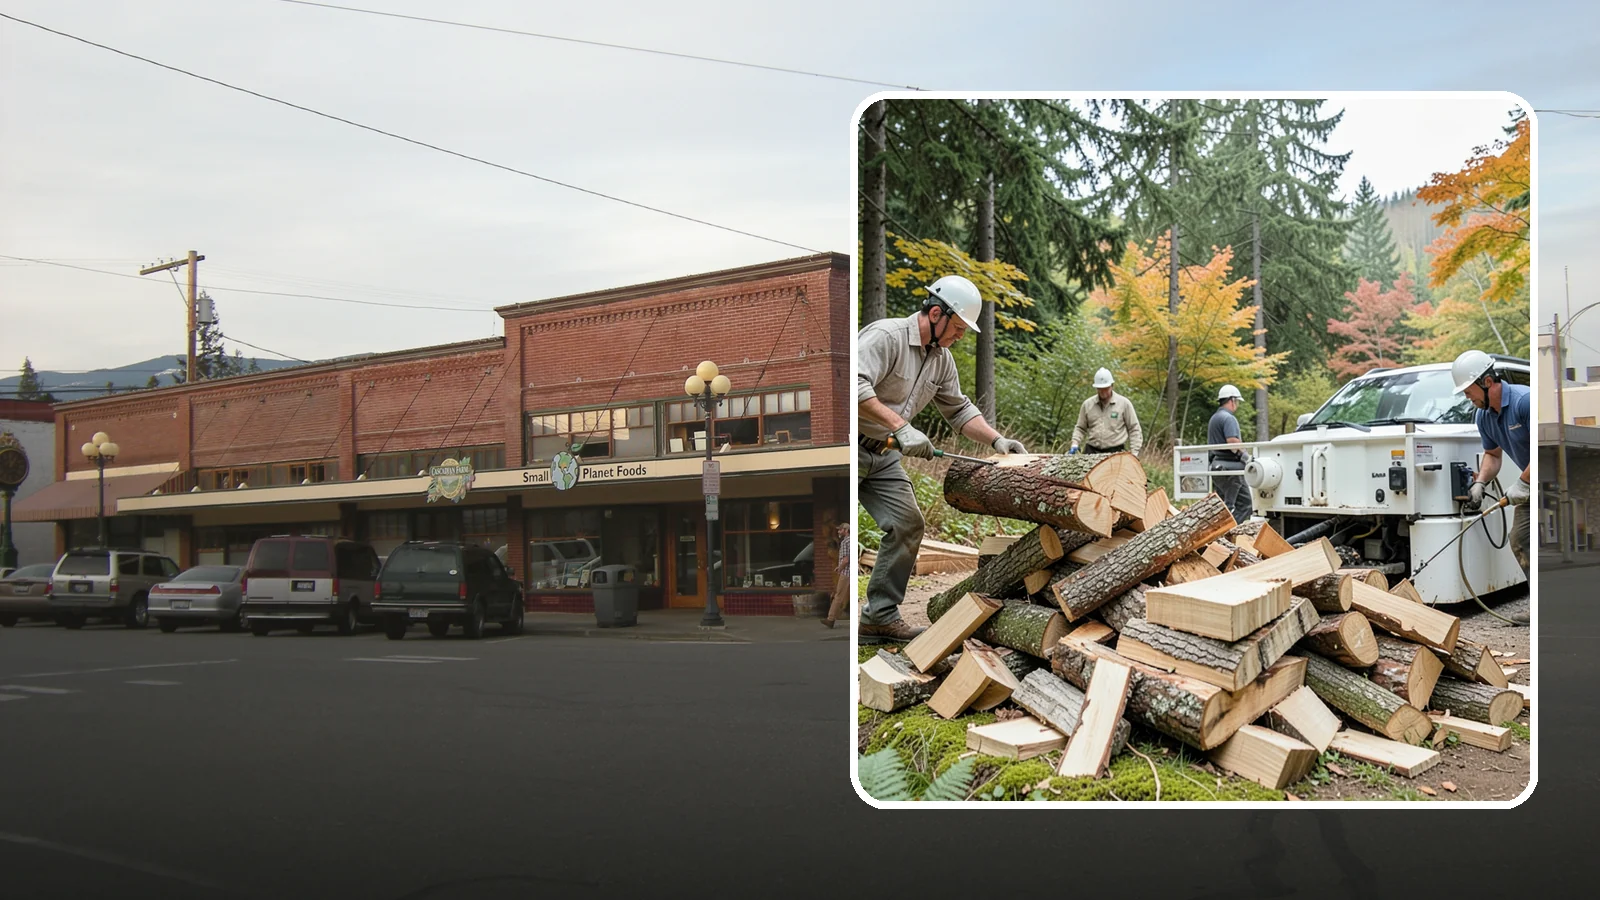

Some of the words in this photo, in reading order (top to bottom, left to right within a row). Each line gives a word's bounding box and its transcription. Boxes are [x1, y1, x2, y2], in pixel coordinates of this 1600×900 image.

[523, 470, 549, 483] Small
[583, 468, 614, 479] Planet
[616, 464, 647, 477] Foods
